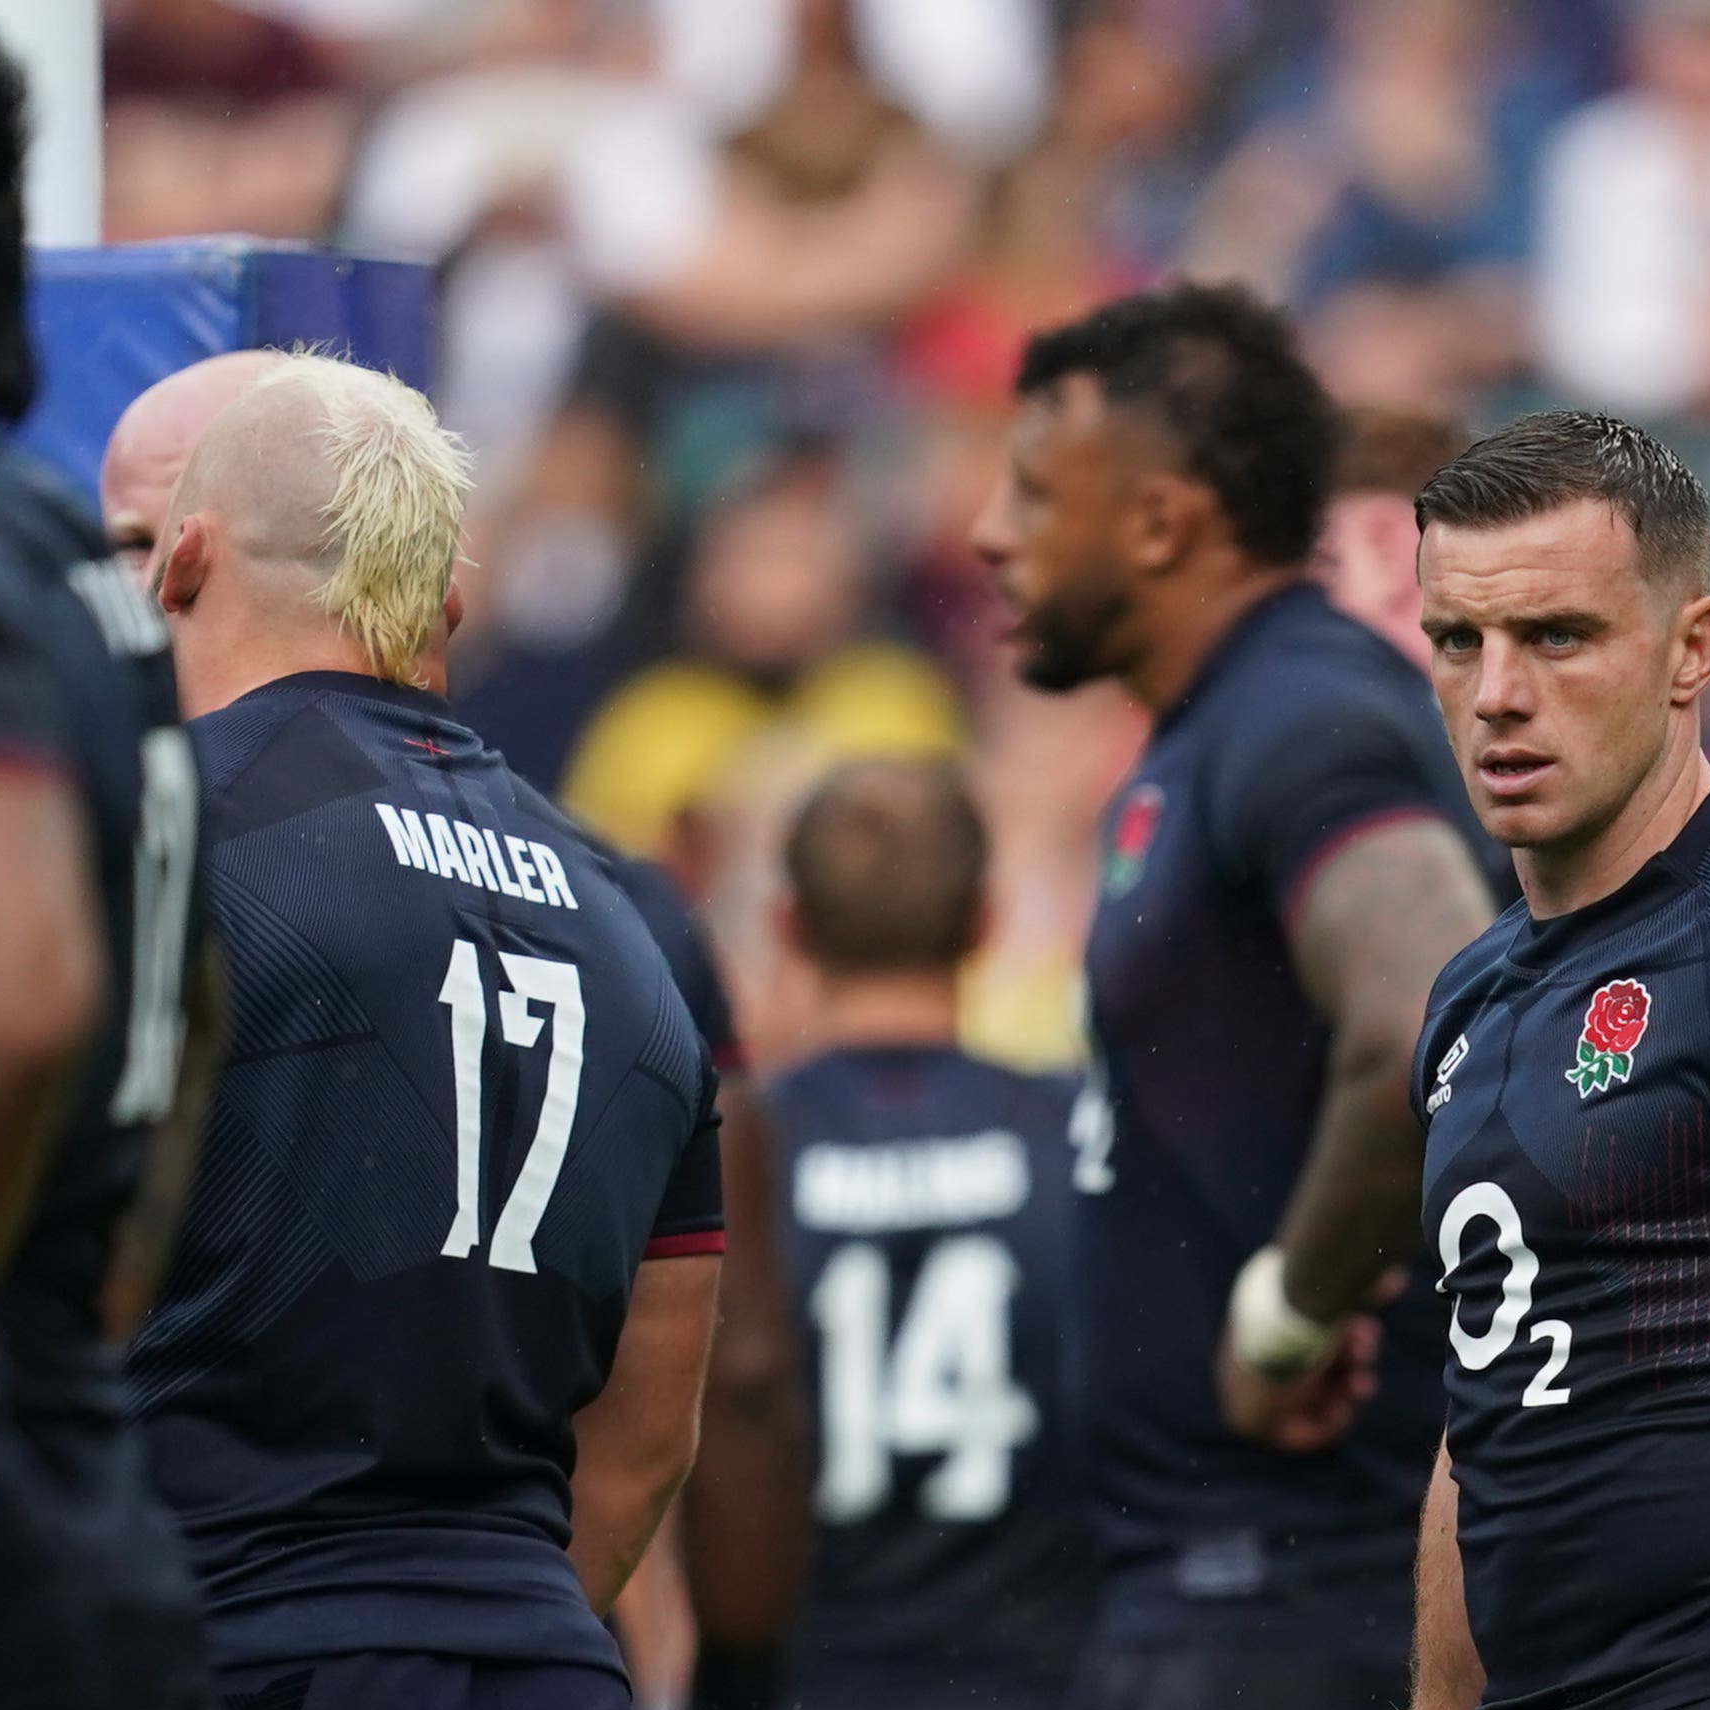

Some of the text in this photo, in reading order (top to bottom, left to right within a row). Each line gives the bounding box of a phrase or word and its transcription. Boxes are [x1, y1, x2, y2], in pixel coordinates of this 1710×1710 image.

[375, 803, 579, 910] MARLER
[437, 938, 587, 1275] 17
[809, 1235, 1043, 1526] 14
[1435, 1181, 1573, 1408] O2
